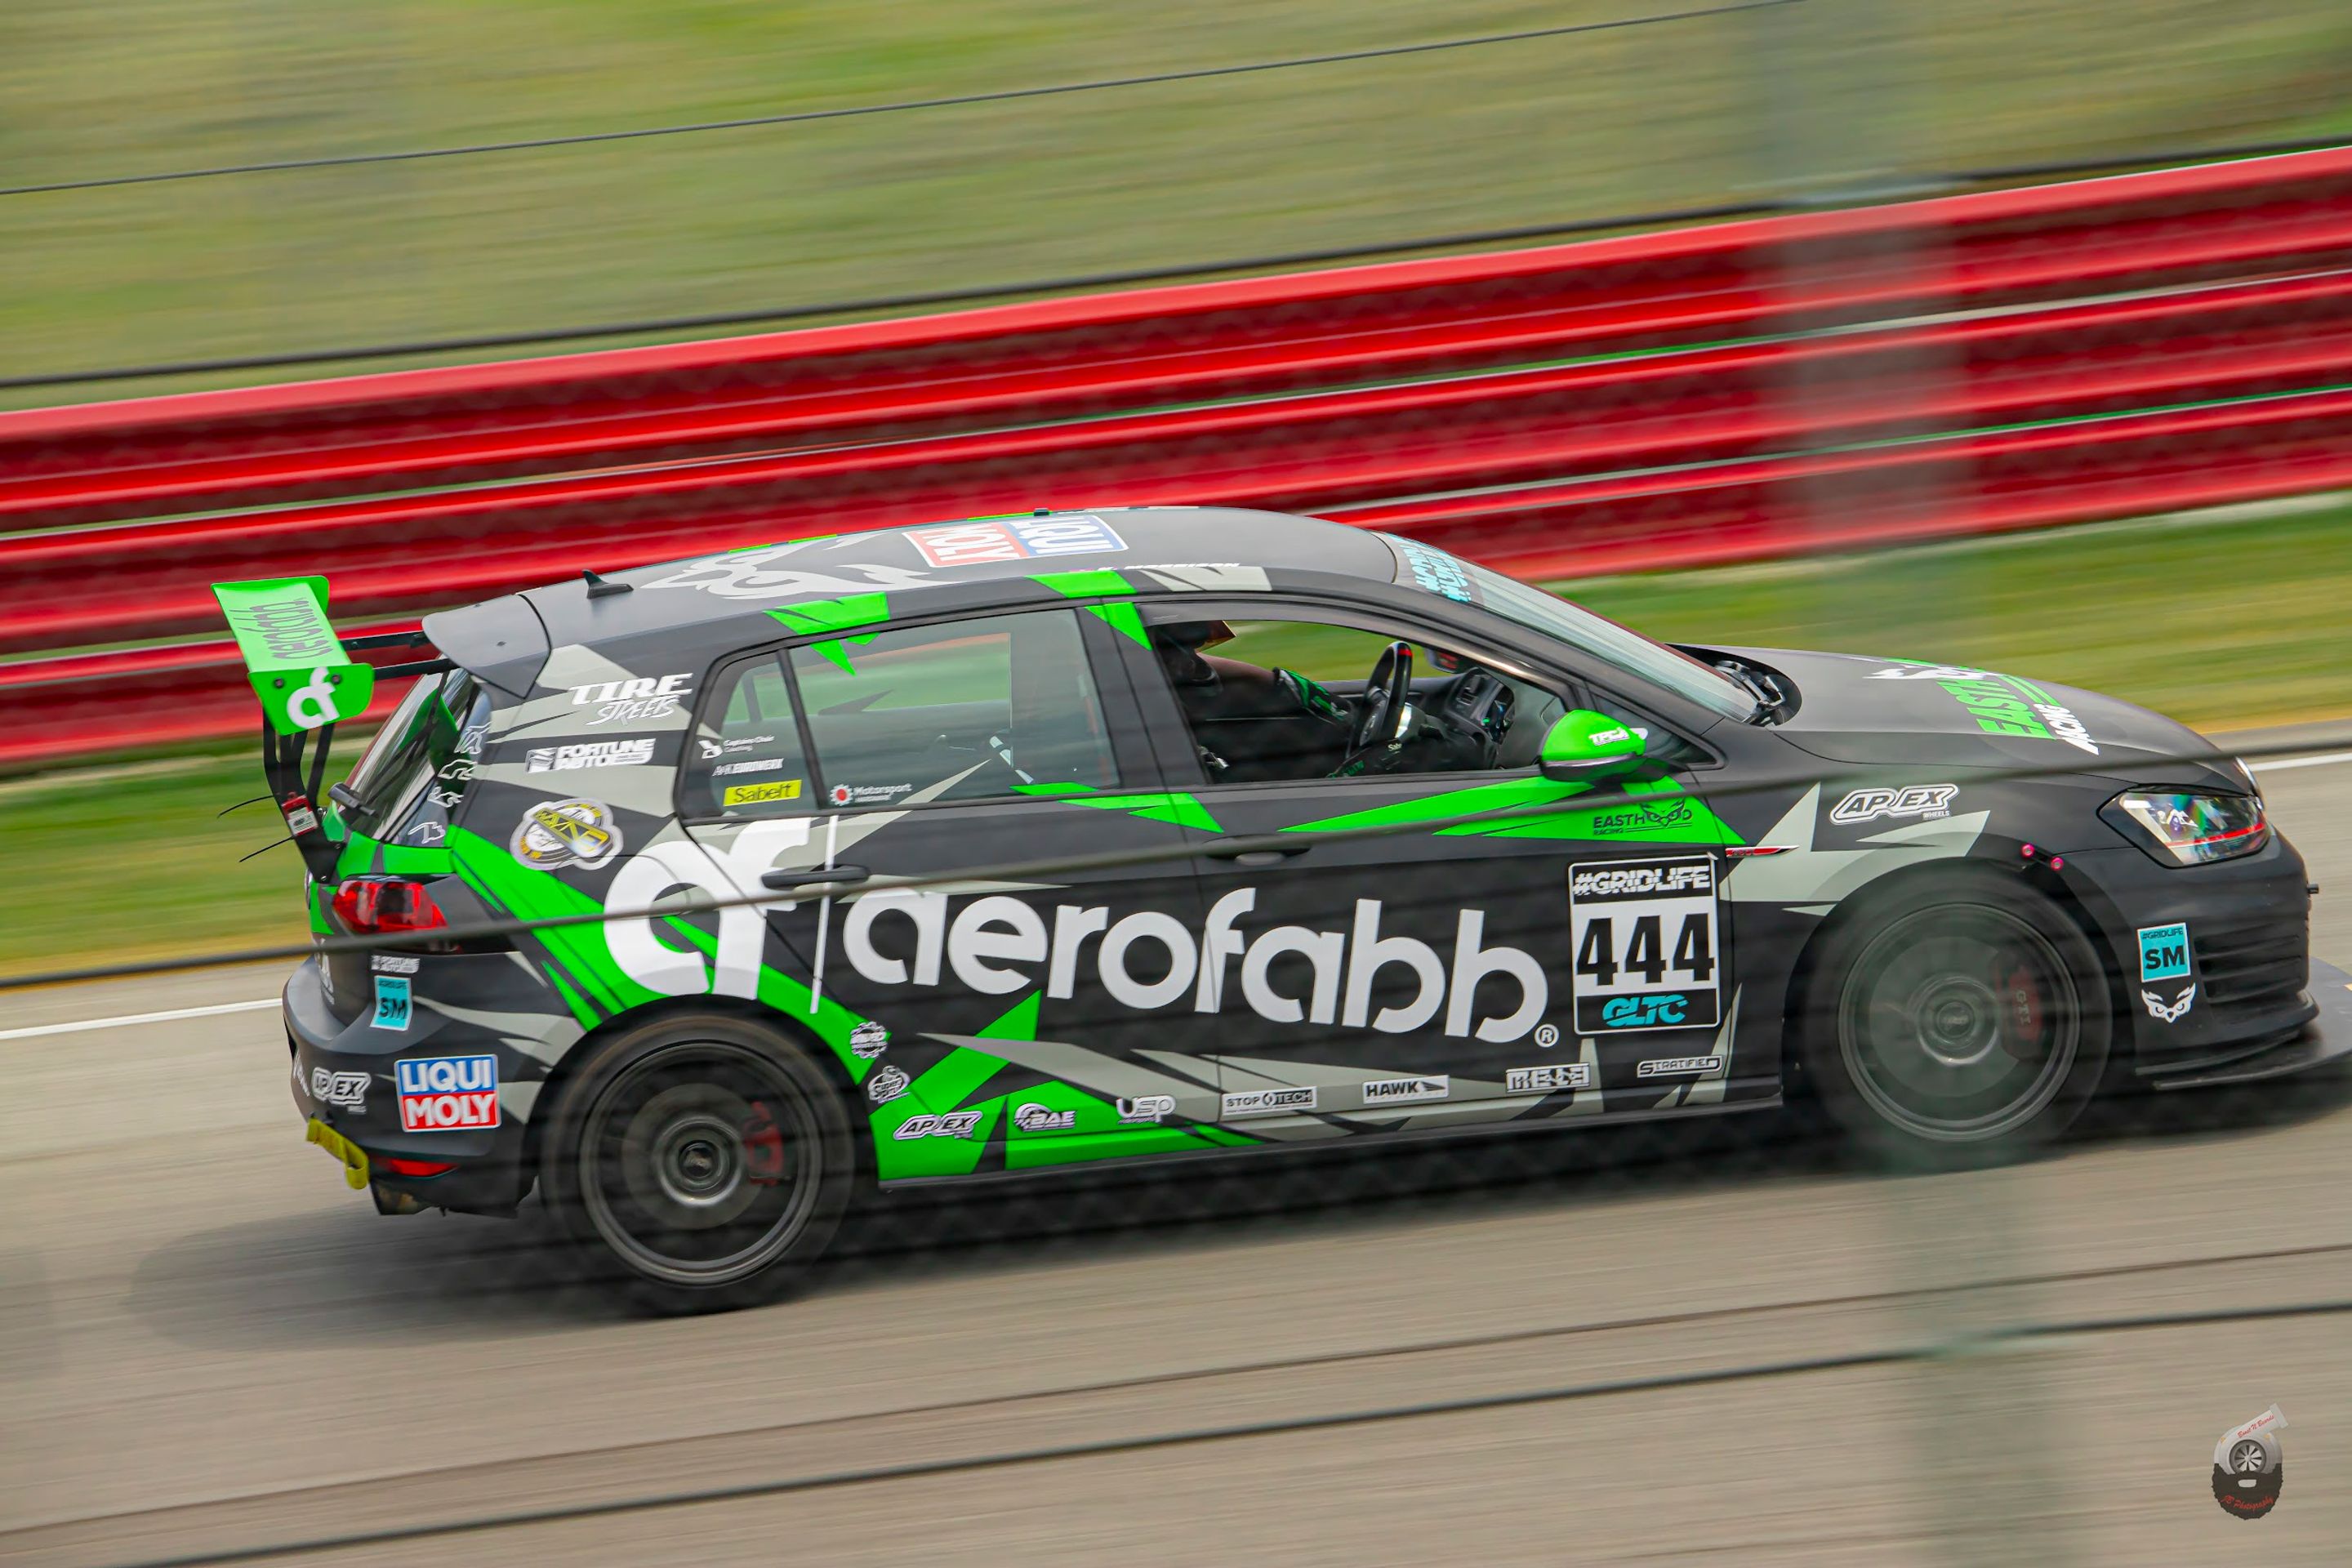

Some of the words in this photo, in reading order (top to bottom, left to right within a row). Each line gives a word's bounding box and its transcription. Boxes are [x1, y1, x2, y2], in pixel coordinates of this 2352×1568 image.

[570, 673, 693, 706] TIRE
[586, 694, 680, 726] STREETS
[556, 738, 657, 759] FORTUNE
[553, 755, 610, 770] AUTO
[733, 783, 792, 803] Sabelt
[1838, 788, 1947, 817] APEX
[1922, 809, 1950, 820] WHEELS
[1572, 865, 1711, 897] #GRIDLIFE
[2140, 926, 2185, 940] #GRIDLIFE
[1576, 911, 1716, 987] 444
[2144, 944, 2186, 970] SM
[843, 887, 1548, 1044] aerofabb
[379, 996, 407, 1020] SM
[1601, 993, 1689, 1027] GLTC
[399, 1058, 492, 1094] LIQUI
[1365, 1080, 1420, 1098] HAWK
[403, 1092, 497, 1128] MOLY
[900, 1115, 975, 1136] APEX
